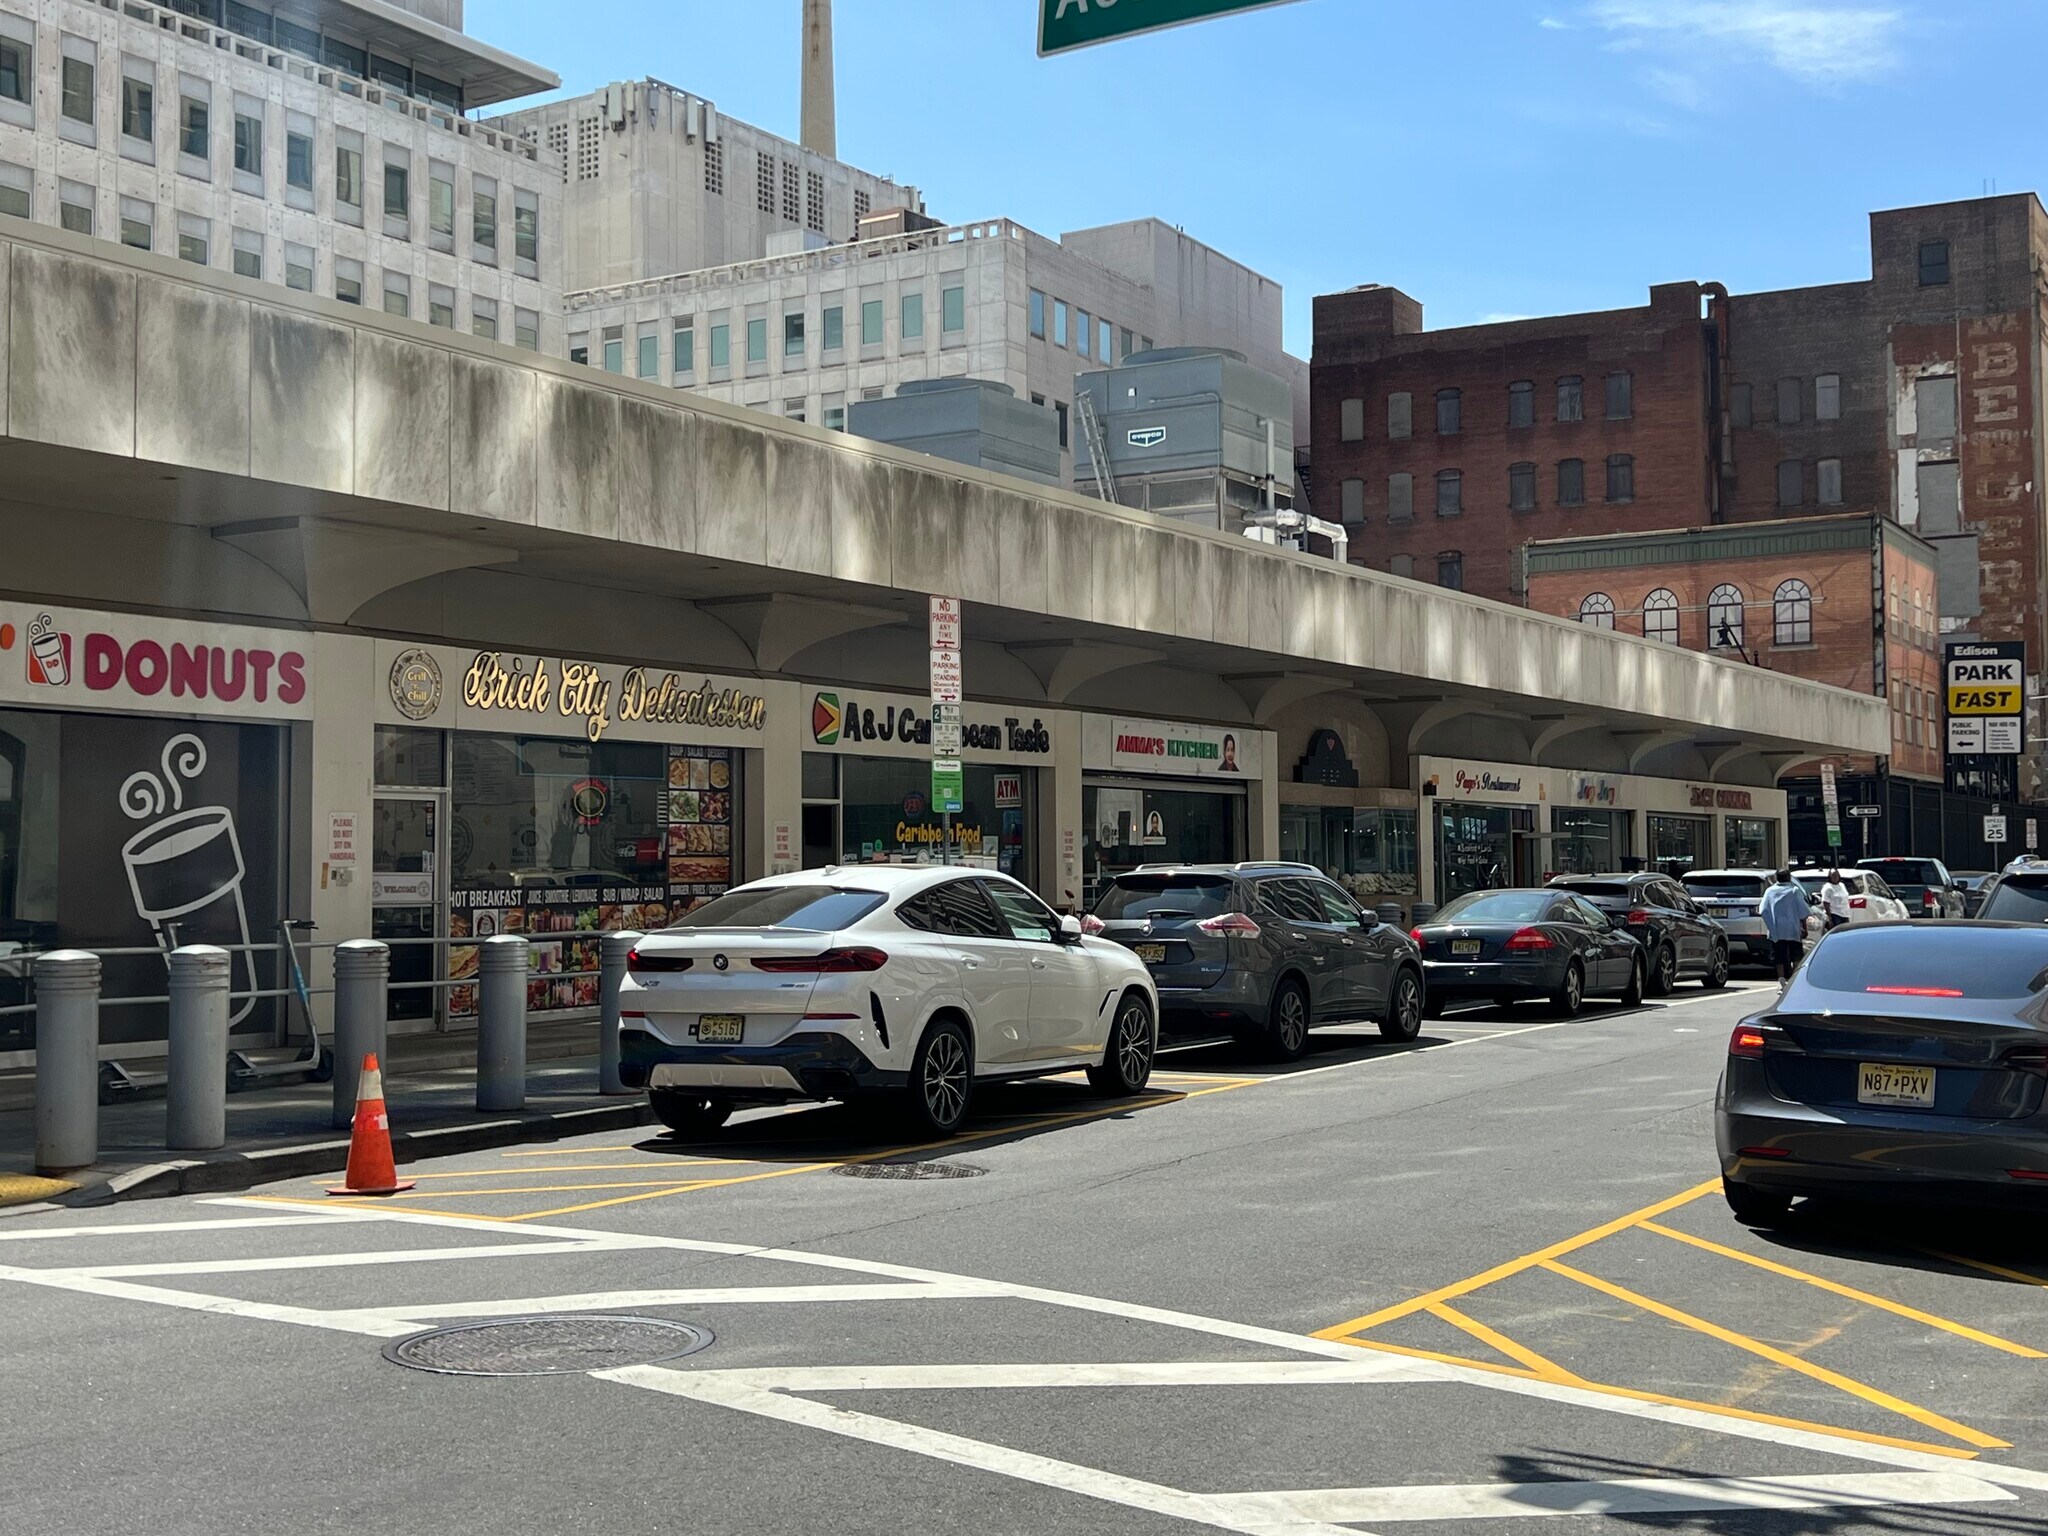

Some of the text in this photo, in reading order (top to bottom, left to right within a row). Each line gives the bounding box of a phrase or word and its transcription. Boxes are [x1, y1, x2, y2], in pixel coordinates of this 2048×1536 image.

[939, 601, 950, 612] NO
[932, 612, 958, 623] PARKING
[1954, 645, 1998, 657] Edison
[941, 653, 951, 661] NO
[46, 658, 60, 669] DD
[84, 632, 306, 704] DONUTS
[933, 661, 959, 669] PARKING
[407, 671, 427, 681] Grill
[933, 673, 960, 681] STANDING
[1954, 664, 2013, 681] PARK
[407, 691, 427, 701] Chill
[463, 651, 551, 713] Brick
[557, 658, 612, 742] City
[618, 666, 767, 731] Delicatessen
[1955, 691, 2012, 708] FAST
[934, 709, 940, 719] 2
[843, 702, 895, 743] A&J
[1005, 717, 1050, 753] Taste
[670, 746, 684, 757] SOUP
[687, 747, 704, 758] SALAD
[707, 748, 729, 758] DESSERT
[1116, 735, 1219, 760] AMMA'S KITCHEN
[997, 779, 1019, 799] ATM
[333, 819, 352, 827] PLEASE
[333, 830, 352, 838] DO NOT
[956, 823, 981, 843] Food
[1987, 829, 2004, 839] 25
[334, 841, 352, 849] SIT ON
[330, 852, 355, 860] HANDRAIL
[603, 888, 616, 902] SUB
[620, 888, 640, 901] WRAP
[644, 887, 664, 900] SALAD
[670, 884, 689, 895] BURGER
[692, 885, 706, 895] FRIES
[450, 889, 523, 907] HOT BREAKFAST
[527, 890, 542, 904] JUICE
[545, 890, 569, 904] SMOOTHIE
[572, 889, 598, 903] LEMONADE
[717, 1024, 740, 1036] 5161
